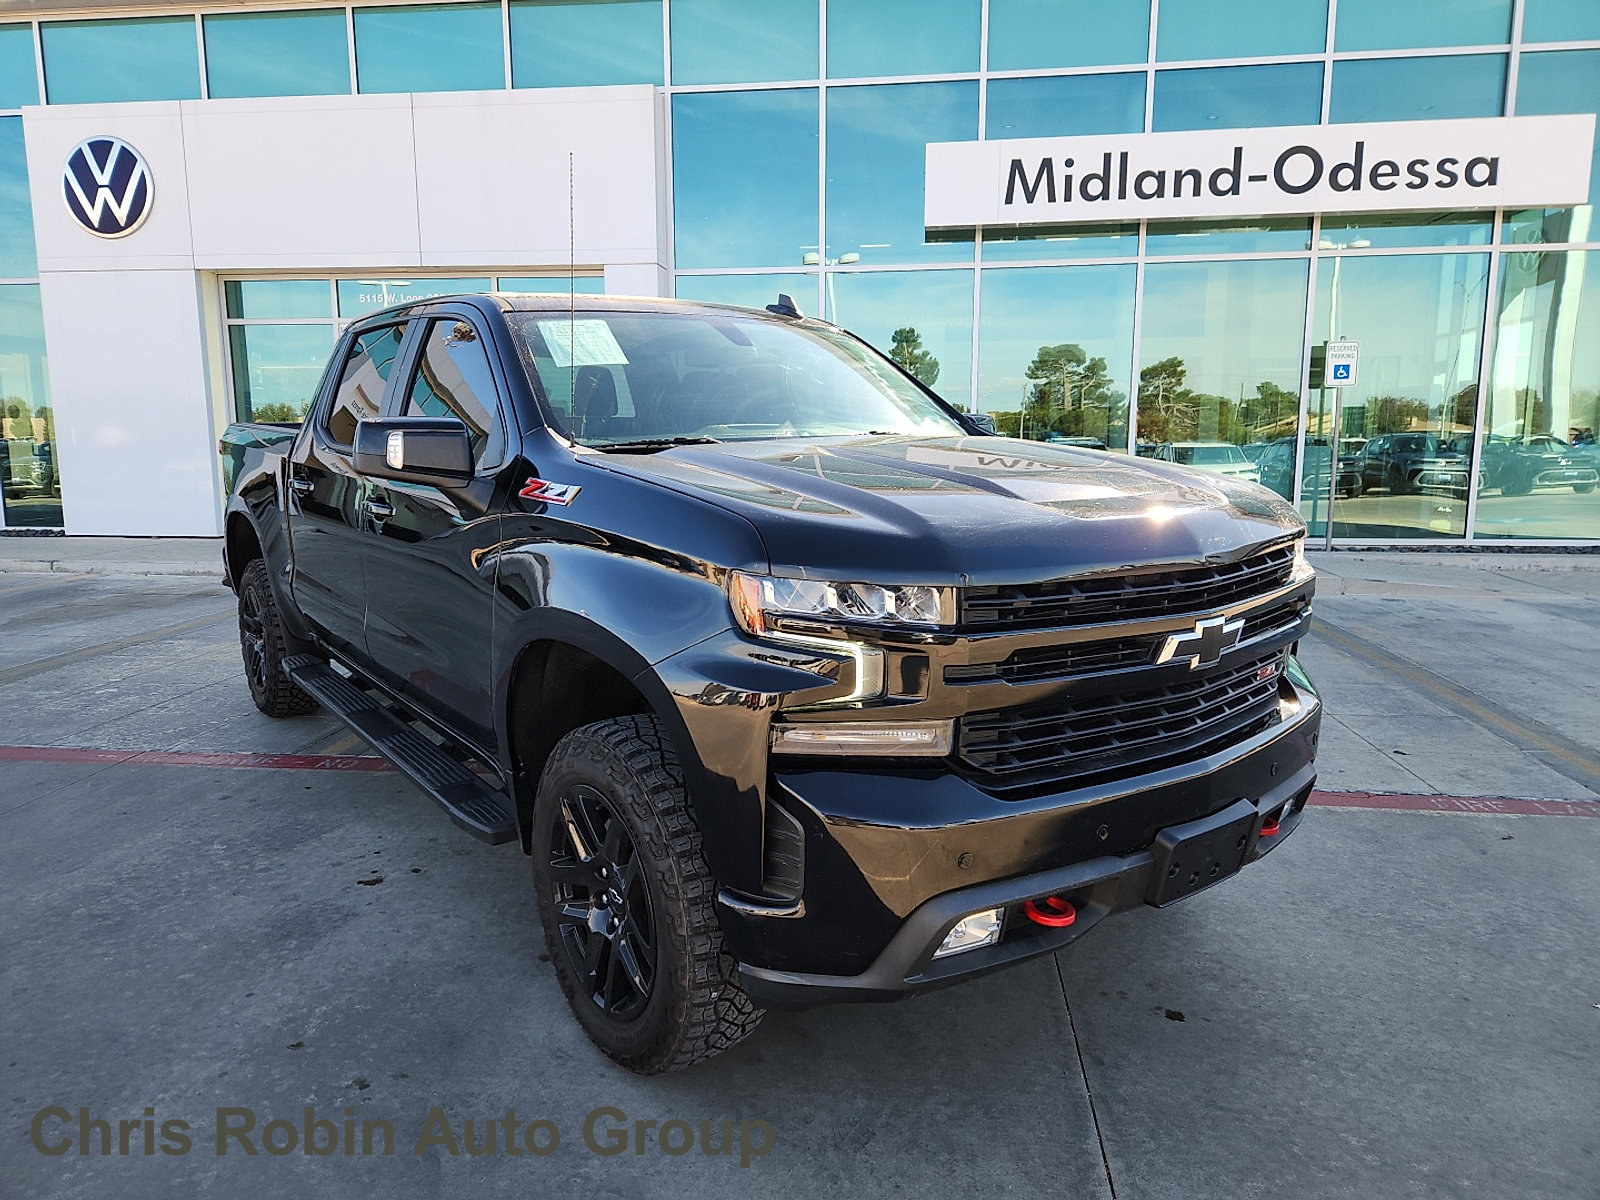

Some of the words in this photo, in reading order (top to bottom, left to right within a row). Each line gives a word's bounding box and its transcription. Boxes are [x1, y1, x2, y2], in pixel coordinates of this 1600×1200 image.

[62, 136, 152, 236] VW
[1004, 141, 1500, 205] Midland-Odessa
[360, 293, 384, 304] 5115
[1430, 798, 1505, 812] FIRE
